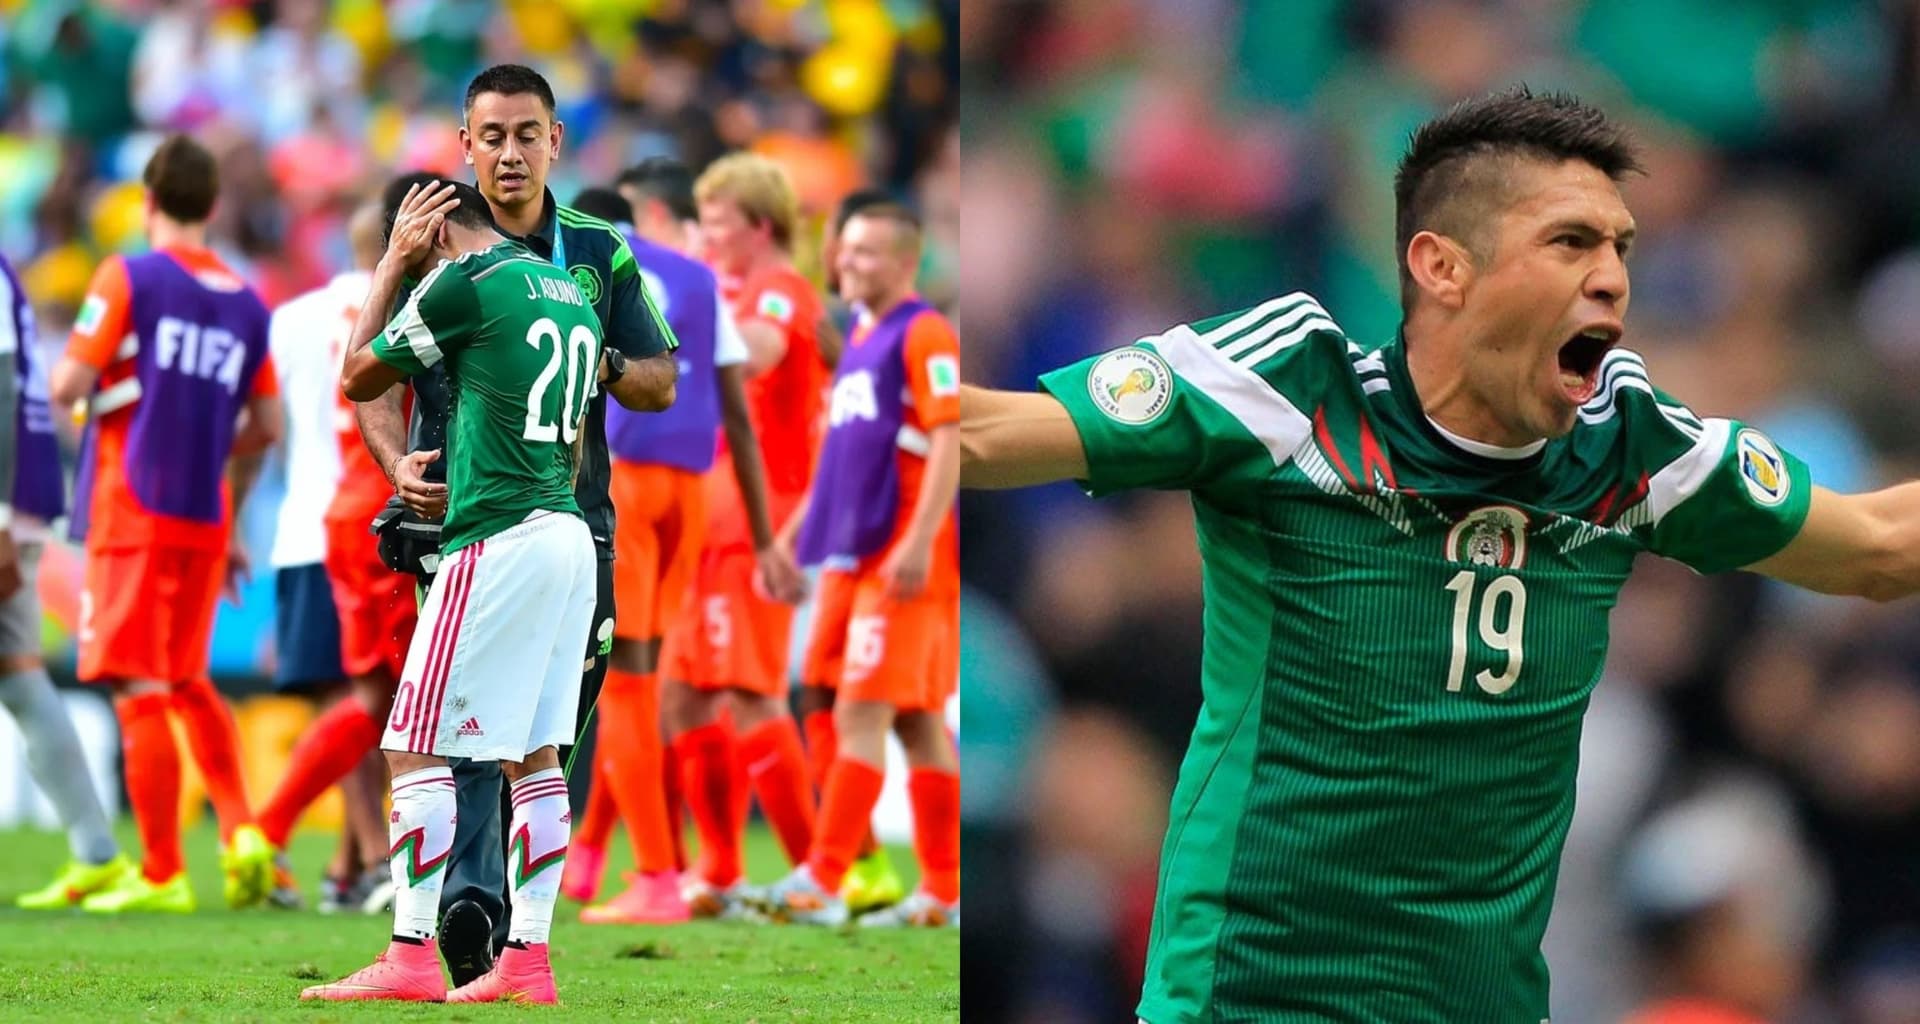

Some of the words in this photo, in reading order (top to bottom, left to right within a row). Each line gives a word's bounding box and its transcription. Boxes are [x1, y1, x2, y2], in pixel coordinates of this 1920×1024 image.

[524, 273, 541, 300] J.
[537, 274, 584, 306] AQUINO
[155, 315, 247, 396] FIFA
[522, 317, 597, 445] 20
[1444, 570, 1527, 695] 19
[456, 728, 485, 737] adidas
